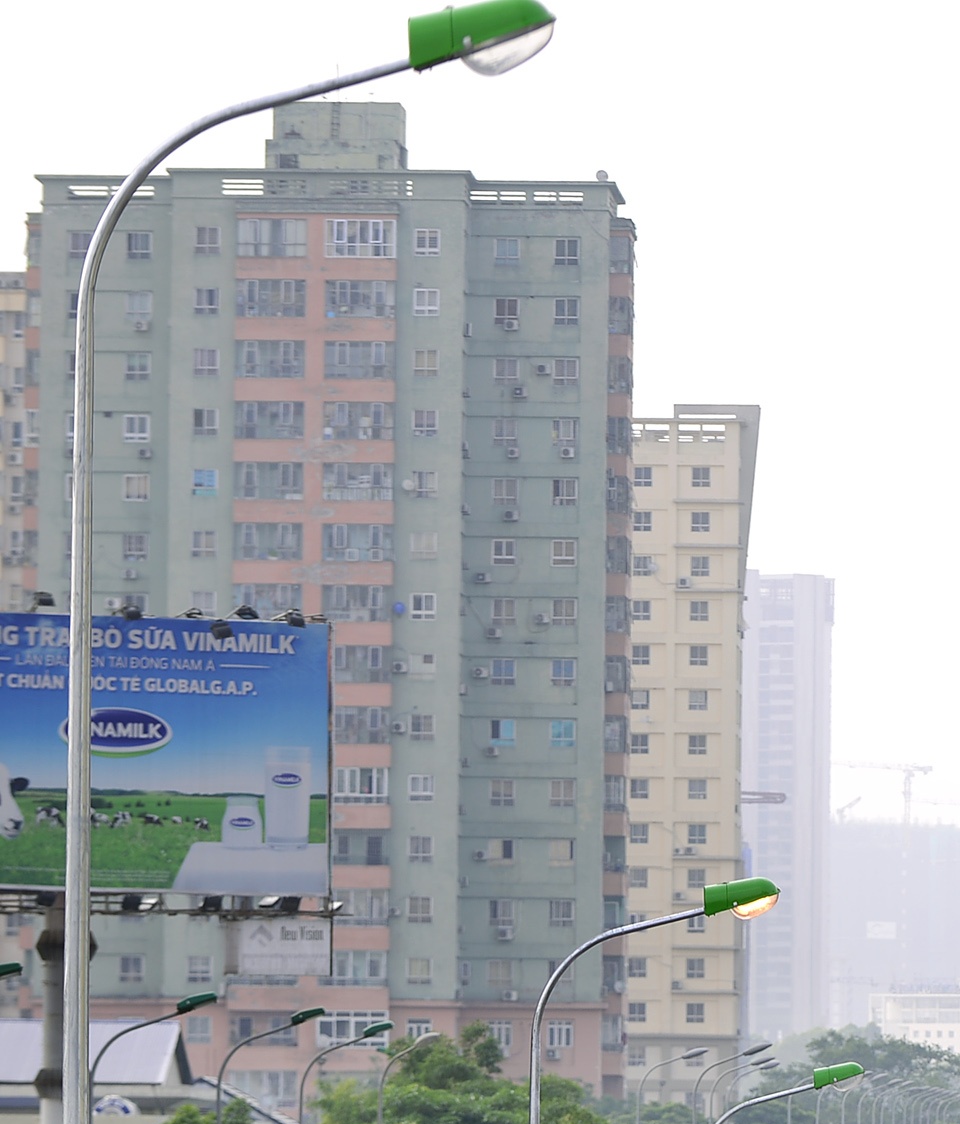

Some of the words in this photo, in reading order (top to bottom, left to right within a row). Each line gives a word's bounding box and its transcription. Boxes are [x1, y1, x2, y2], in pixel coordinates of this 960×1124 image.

[182, 631, 296, 655] VINAMILK
[172, 658, 203, 671] NAM
[91, 721, 163, 739] NAMILK
